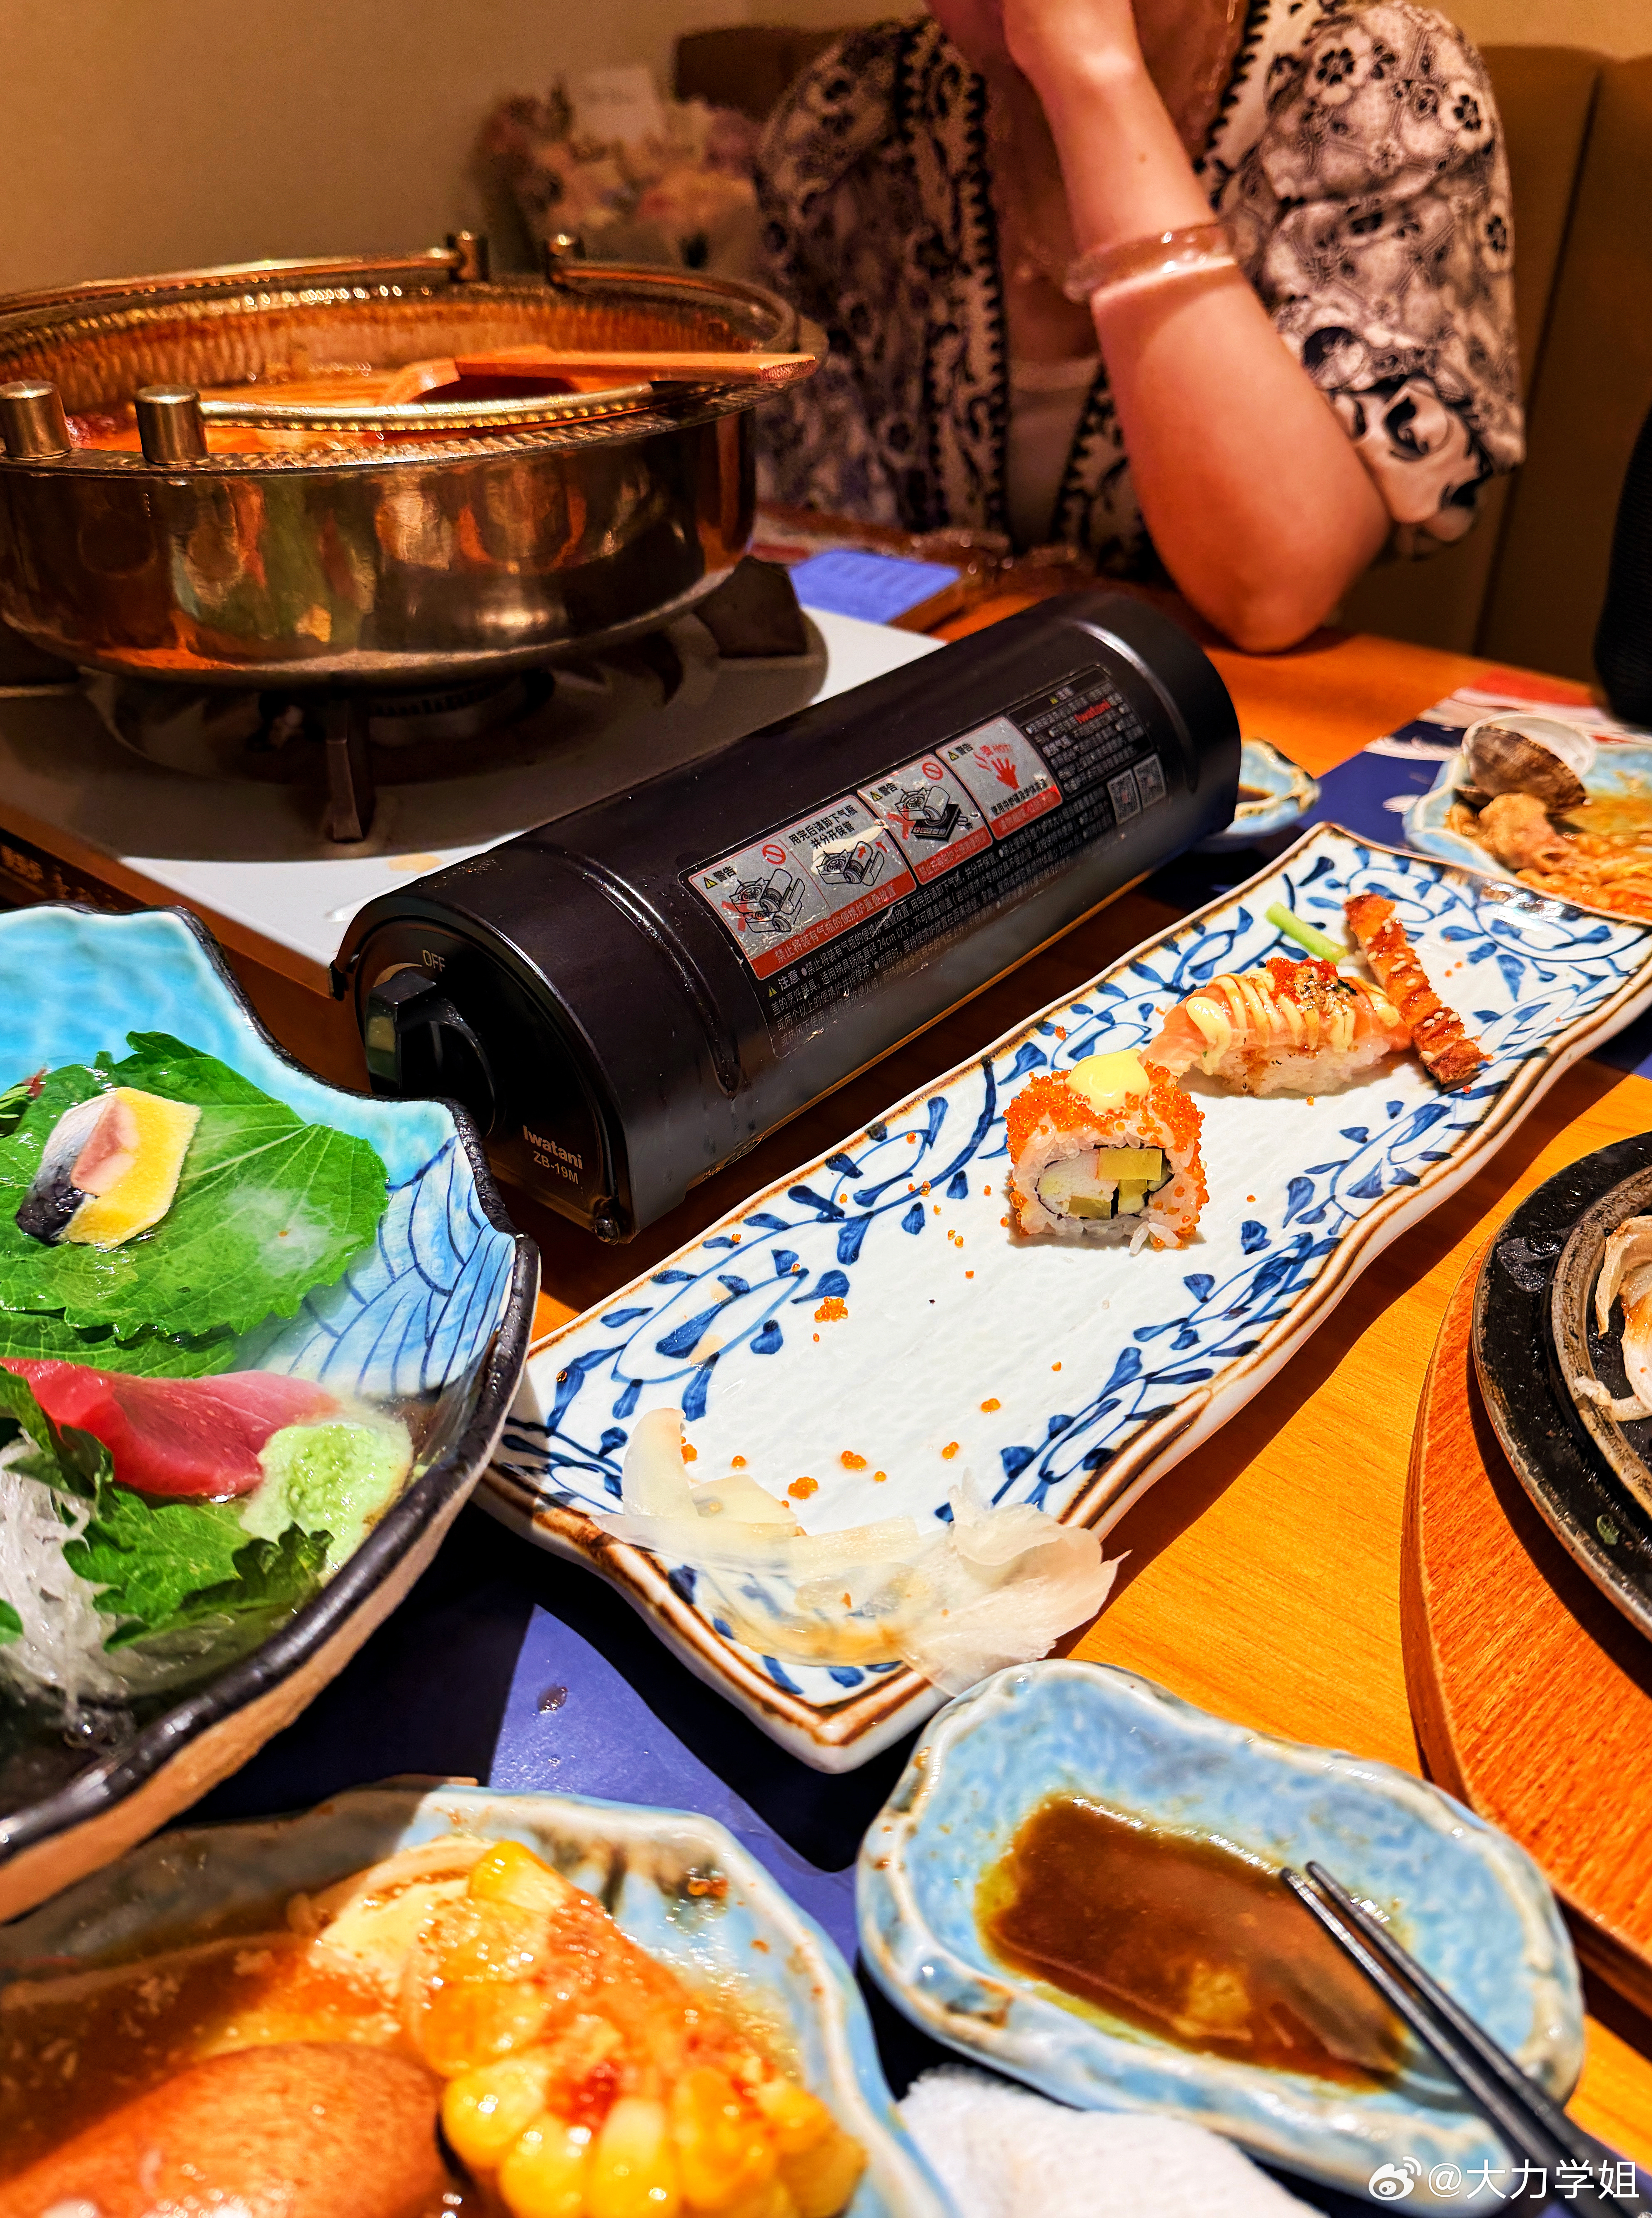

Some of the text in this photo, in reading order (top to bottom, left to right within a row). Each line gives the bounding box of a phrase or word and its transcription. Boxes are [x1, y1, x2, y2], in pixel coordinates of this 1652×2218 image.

[878, 780, 898, 798] 警告
[788, 803, 859, 847] 用完后请卸下气瓶
[811, 818, 857, 851] 并分开保管
[712, 863, 737, 885] 警告
[774, 883, 898, 965] 禁止将装有气瓶的便携炉重叠放置
[422, 949, 446, 972] OFF
[776, 968, 802, 991] 注意
[522, 1125, 583, 1169] Iwatani
[533, 1150, 579, 1185] ZB-19M
